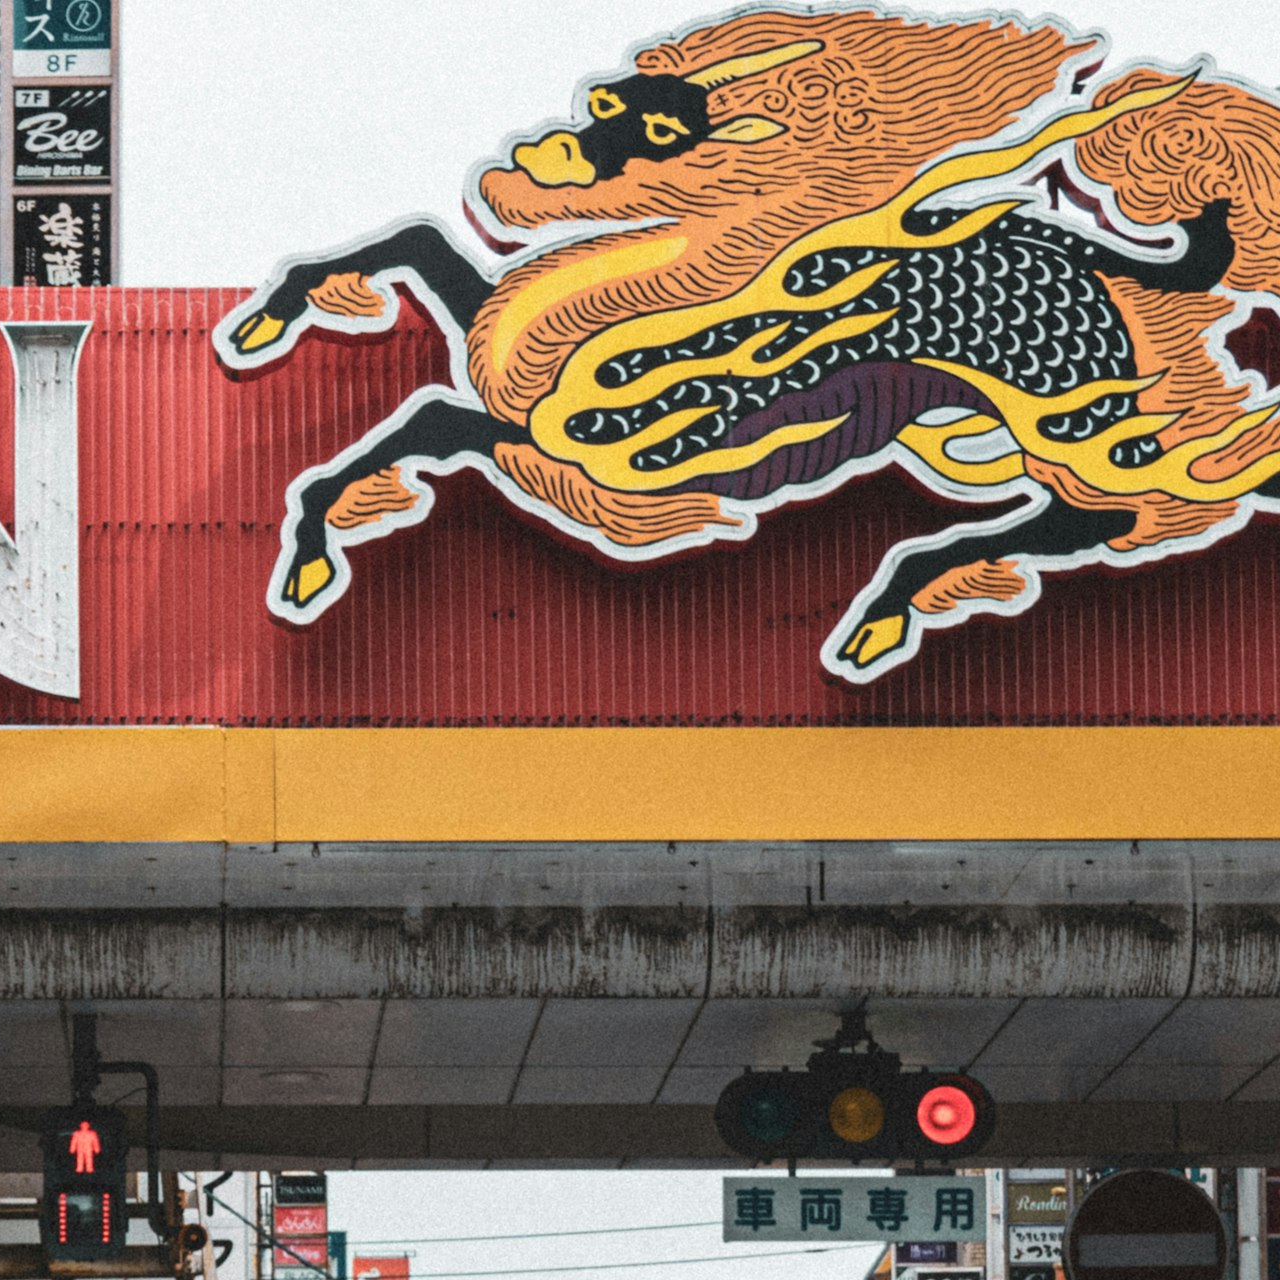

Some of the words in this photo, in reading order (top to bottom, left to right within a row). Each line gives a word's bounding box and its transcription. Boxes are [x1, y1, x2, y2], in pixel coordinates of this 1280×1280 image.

[21, 94, 43, 104] 7F
[17, 112, 104, 152] Bee
[17, 200, 36, 211] 6F
[734, 1187, 975, 1231] 車両専用
